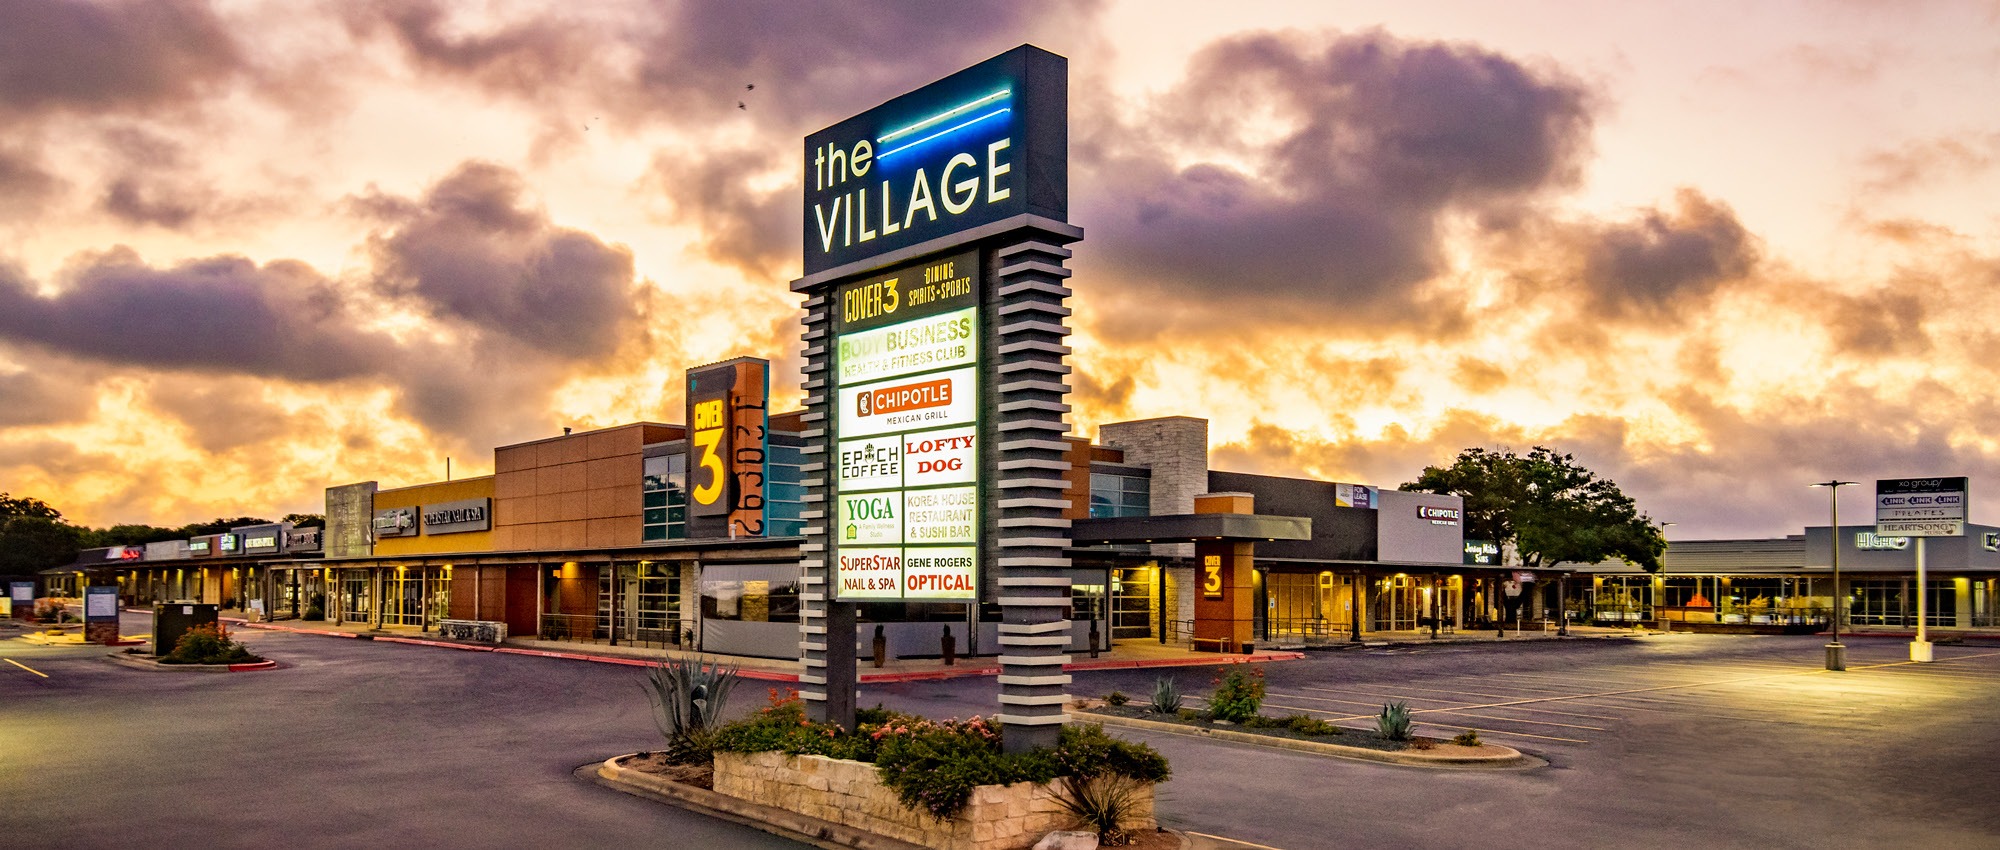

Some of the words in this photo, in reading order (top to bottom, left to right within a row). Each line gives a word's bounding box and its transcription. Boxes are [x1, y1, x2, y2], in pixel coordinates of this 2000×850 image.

[814, 139, 873, 191] the
[814, 137, 1011, 253] VILLAGE
[925, 261, 954, 285] DINING
[844, 282, 882, 323] COVER
[882, 277, 899, 313] 3
[841, 336, 883, 362] BODY
[886, 317, 971, 353] BUSINESS
[891, 351, 933, 370] FITNESS
[935, 345, 966, 361] CLUB
[875, 383, 950, 410] CHIPOTLE
[694, 400, 724, 431] COVER
[886, 414, 922, 425] MEXICAN
[924, 410, 948, 420] GRILL
[906, 435, 976, 455] LOFTY
[692, 427, 725, 505] 3
[842, 462, 899, 479] COFFEE
[917, 457, 963, 474] DOG
[846, 497, 894, 521] YOGA
[907, 495, 939, 508] KOREA
[941, 492, 975, 506] HOUSE
[1884, 497, 1905, 505] LINK
[1911, 496, 1932, 504] LINK
[1938, 495, 1960, 504] LINK
[909, 509, 973, 523] RESTAURANT
[1427, 508, 1459, 519] CHIPOTLE
[910, 527, 918, 539] &
[919, 526, 948, 539] SUSHI
[949, 525, 971, 538] BAR
[907, 558, 932, 568] GENE
[934, 557, 973, 568] ROGERS
[844, 578, 866, 591] NAIL
[868, 578, 876, 590] &
[878, 577, 896, 591] SPA
[907, 574, 974, 591] OPTICAL
[1204, 566, 1221, 592] 3
